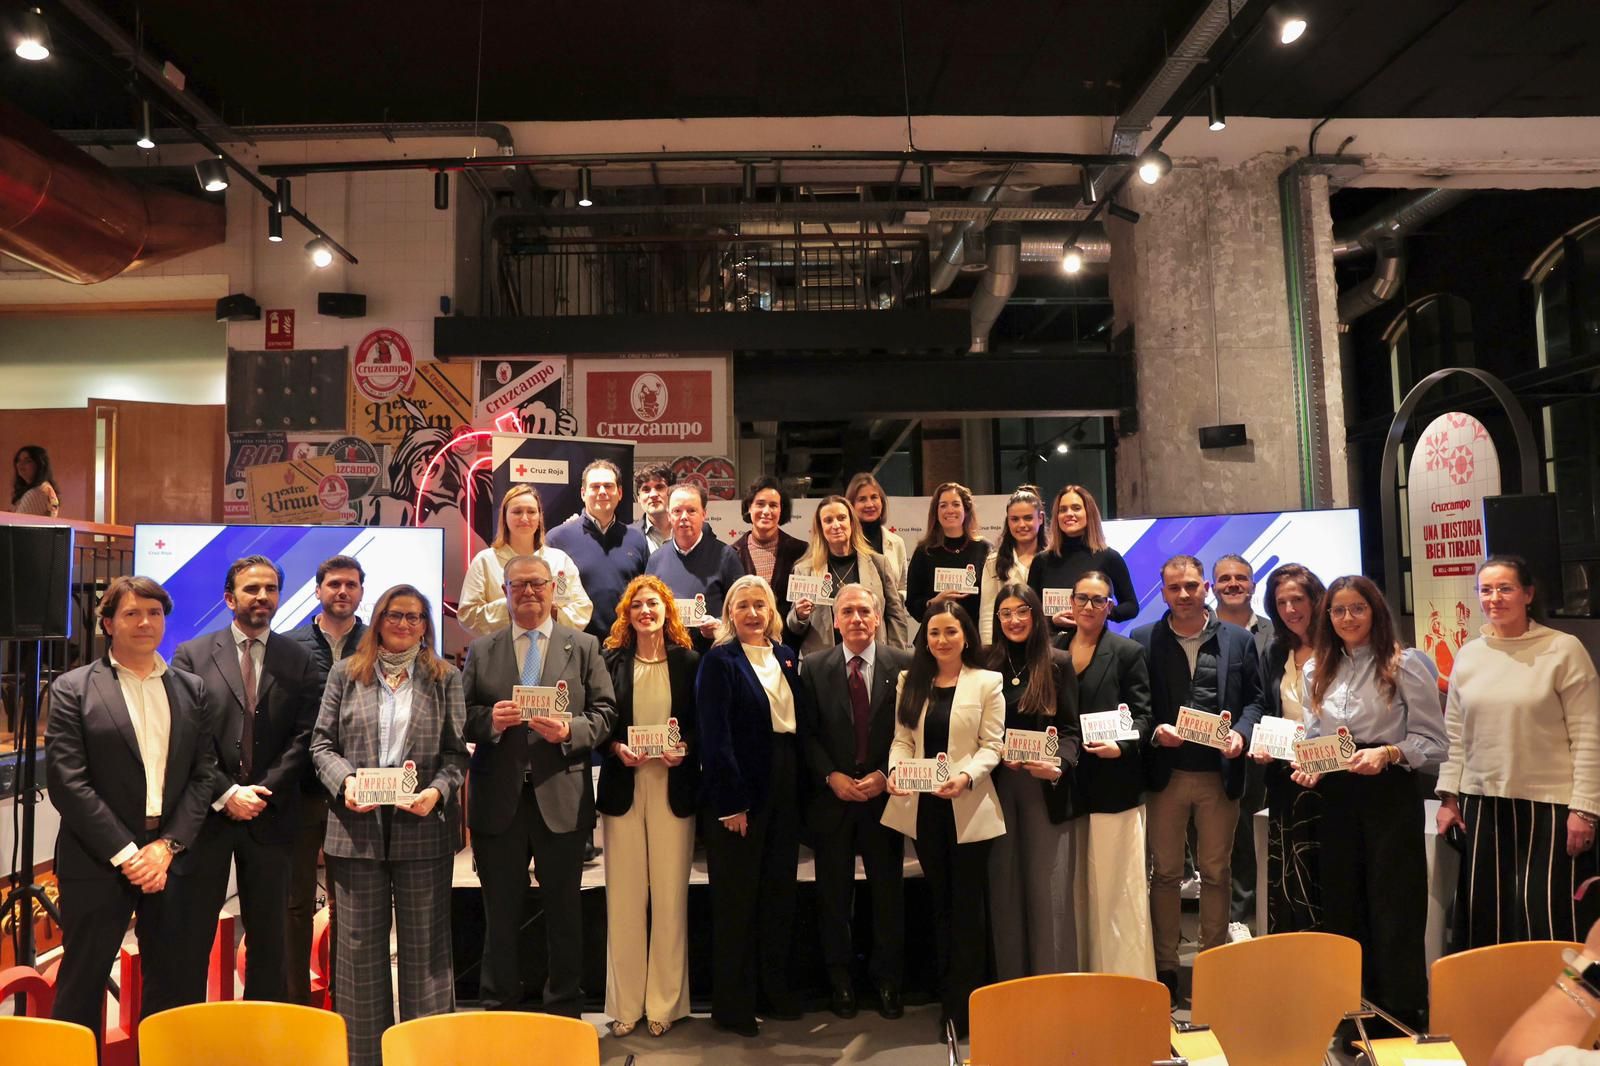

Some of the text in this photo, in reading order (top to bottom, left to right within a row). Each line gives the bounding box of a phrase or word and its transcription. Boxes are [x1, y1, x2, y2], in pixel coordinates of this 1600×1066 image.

[358, 364, 410, 375] Cruzcampo
[484, 364, 554, 414] Cruzcampo
[596, 420, 703, 440] Cruzcampo
[234, 444, 283, 467] BIG
[1432, 499, 1471, 512] Cruzcampo
[1424, 518, 1482, 541] UNA HISTORIA
[1426, 539, 1482, 560] BIEN TIRADA
[936, 573, 963, 583] EMPRESA
[790, 581, 818, 593] EMPRESA
[522, 707, 550, 719] CONOCIDA
[1084, 719, 1117, 731] EMPRESA
[1181, 716, 1213, 733] EMPRESA
[631, 733, 664, 745] EMPRESA
[1086, 729, 1118, 741] RECONOCIDA
[1178, 726, 1210, 744] RECONOCIDA
[1255, 732, 1287, 746] EMPRESA
[1009, 738, 1040, 750] EMPRESA
[1008, 750, 1040, 760] RECONOCIDA
[1297, 745, 1337, 761] EMPRESA
[1300, 758, 1339, 774] RECONOCIDA
[898, 767, 932, 778] EMPRESA
[358, 777, 397, 789] EMPRESA
[898, 779, 932, 790] RECONOCIDA
[358, 790, 396, 802] RECONOCIDA
